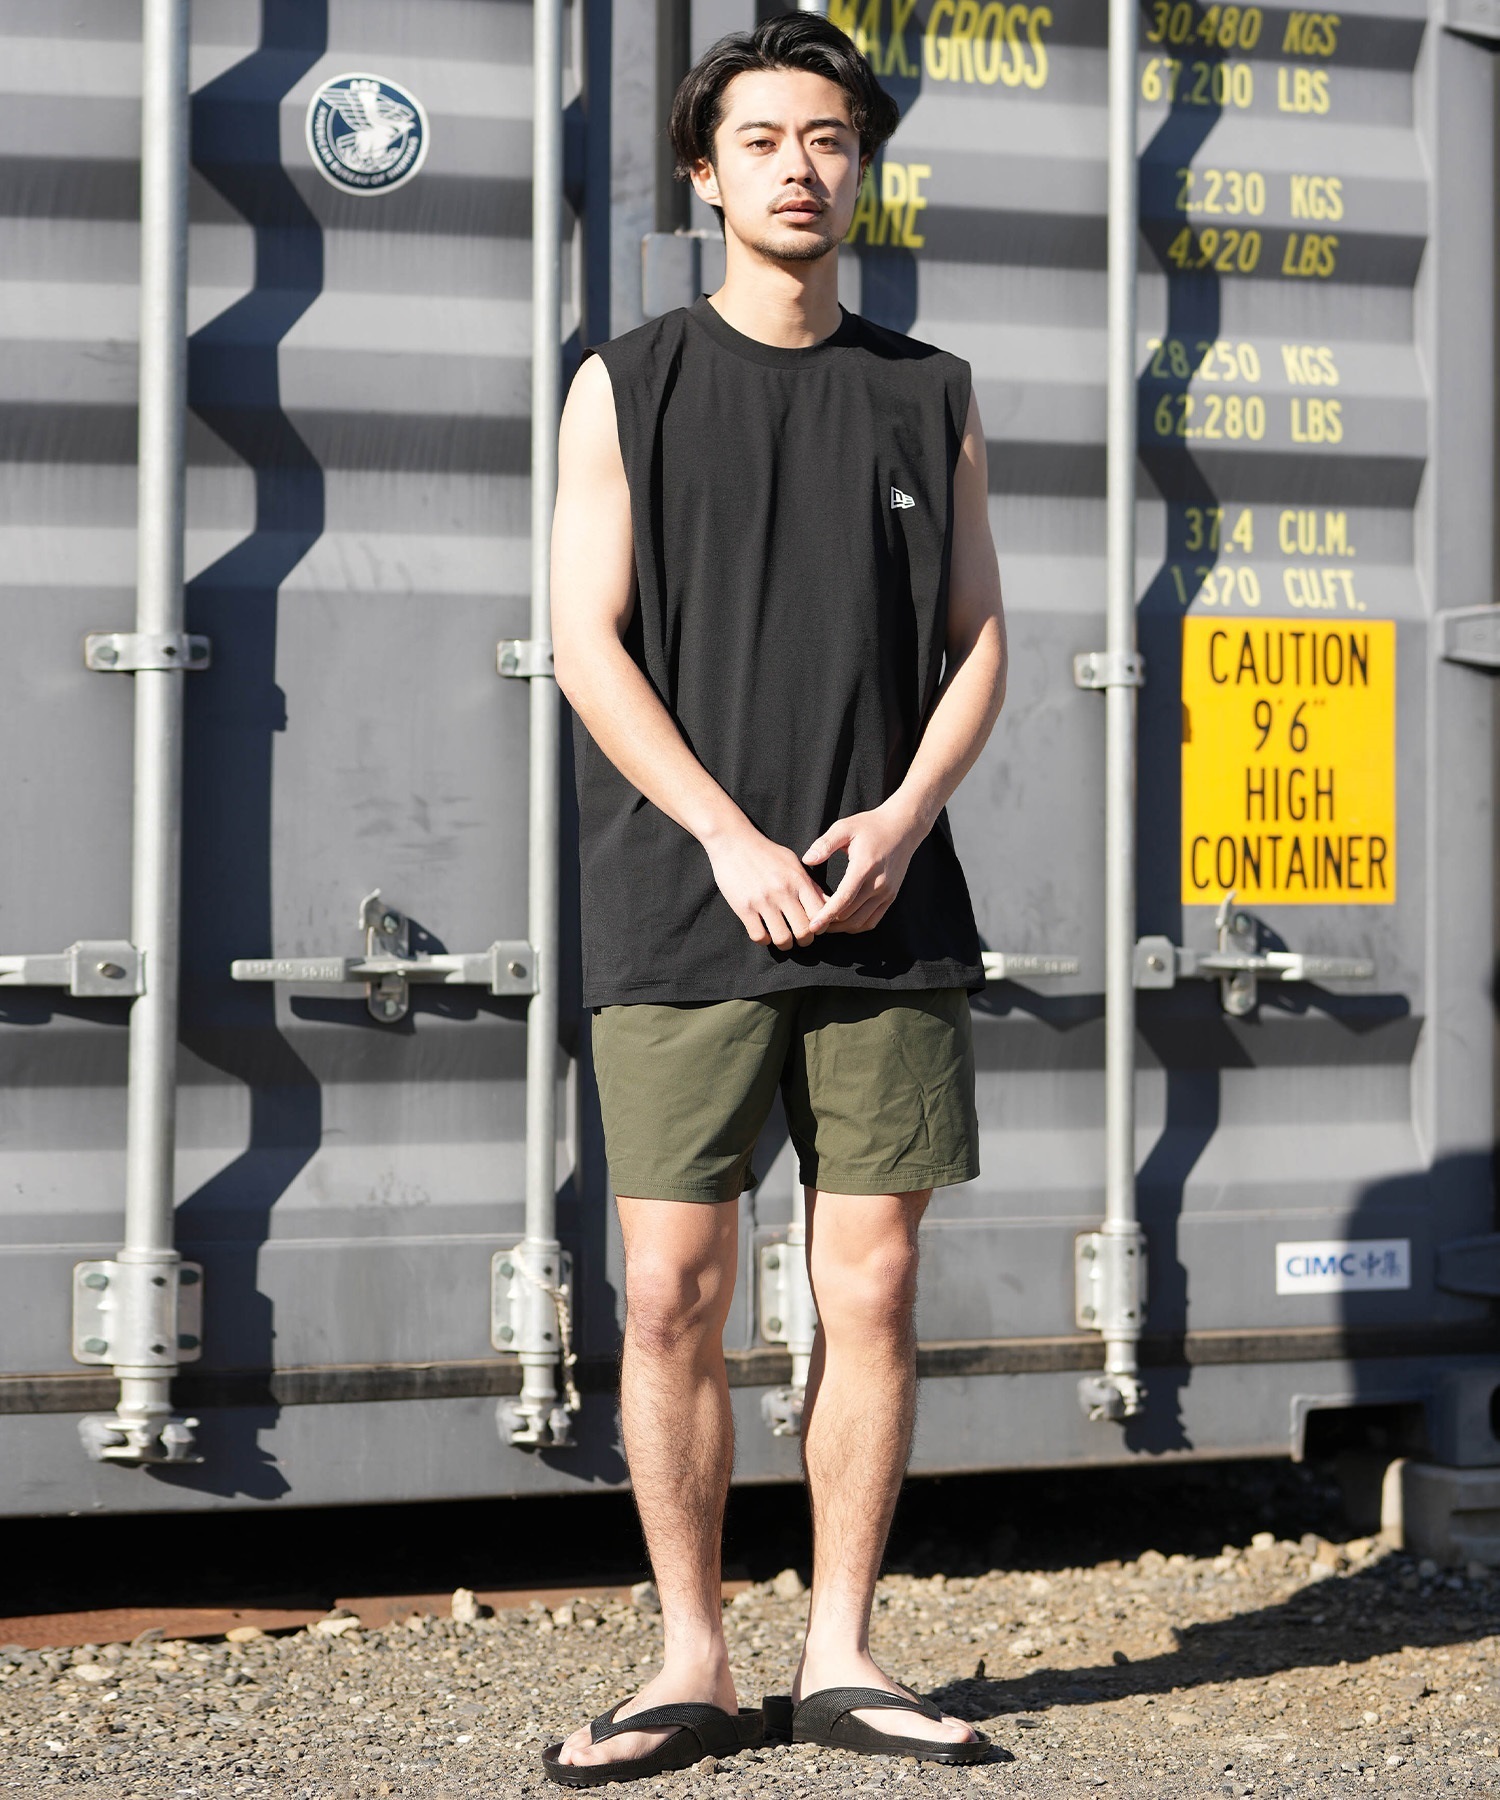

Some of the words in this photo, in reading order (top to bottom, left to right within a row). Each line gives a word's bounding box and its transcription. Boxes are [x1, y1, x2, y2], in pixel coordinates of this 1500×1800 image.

[924, 2, 1053, 89] GROSS
[1146, 3, 1263, 49] 30.480
[1282, 11, 1342, 56] KGS
[1141, 58, 1253, 109] 67.200
[1277, 66, 1330, 114] LBS
[845, 162, 931, 248] ARE
[1175, 168, 1266, 216] 2.230
[1290, 174, 1344, 222] KGS
[1167, 226, 1261, 273] 4.920
[1281, 232, 1339, 277] LBS
[1146, 337, 1261, 383] 28.250
[1281, 344, 1340, 387] KGS
[1154, 393, 1266, 441] 62.280
[1291, 398, 1344, 444] LBS
[1184, 508, 1253, 554] 37.4
[1279, 509, 1356, 557] CU.M.
[1209, 630, 1369, 686] CAUTION
[1245, 767, 1335, 822] HIGH
[1191, 834, 1387, 890] CONTAINER
[1286, 1254, 1356, 1277] CIMC
